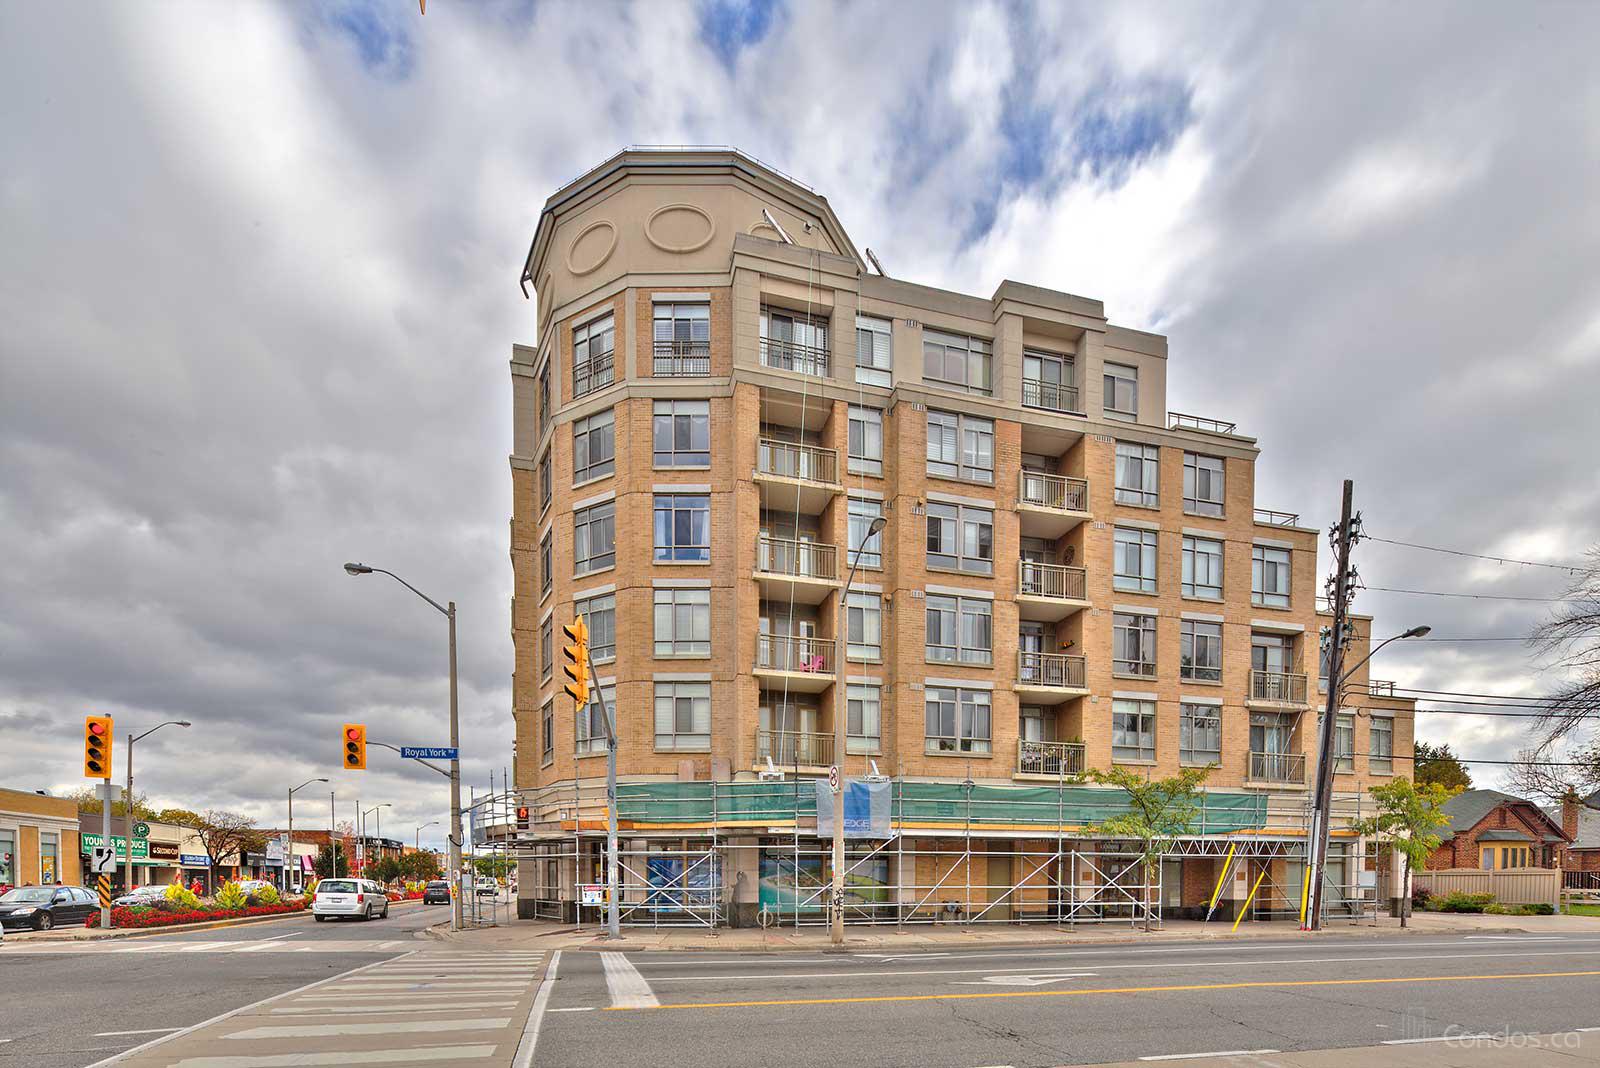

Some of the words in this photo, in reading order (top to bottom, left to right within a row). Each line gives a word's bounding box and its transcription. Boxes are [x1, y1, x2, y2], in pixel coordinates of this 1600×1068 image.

[405, 748, 428, 758] Royal
[429, 749, 447, 757] York
[84, 836, 115, 847] YOUNS
[116, 839, 146, 849] PRDUCE
